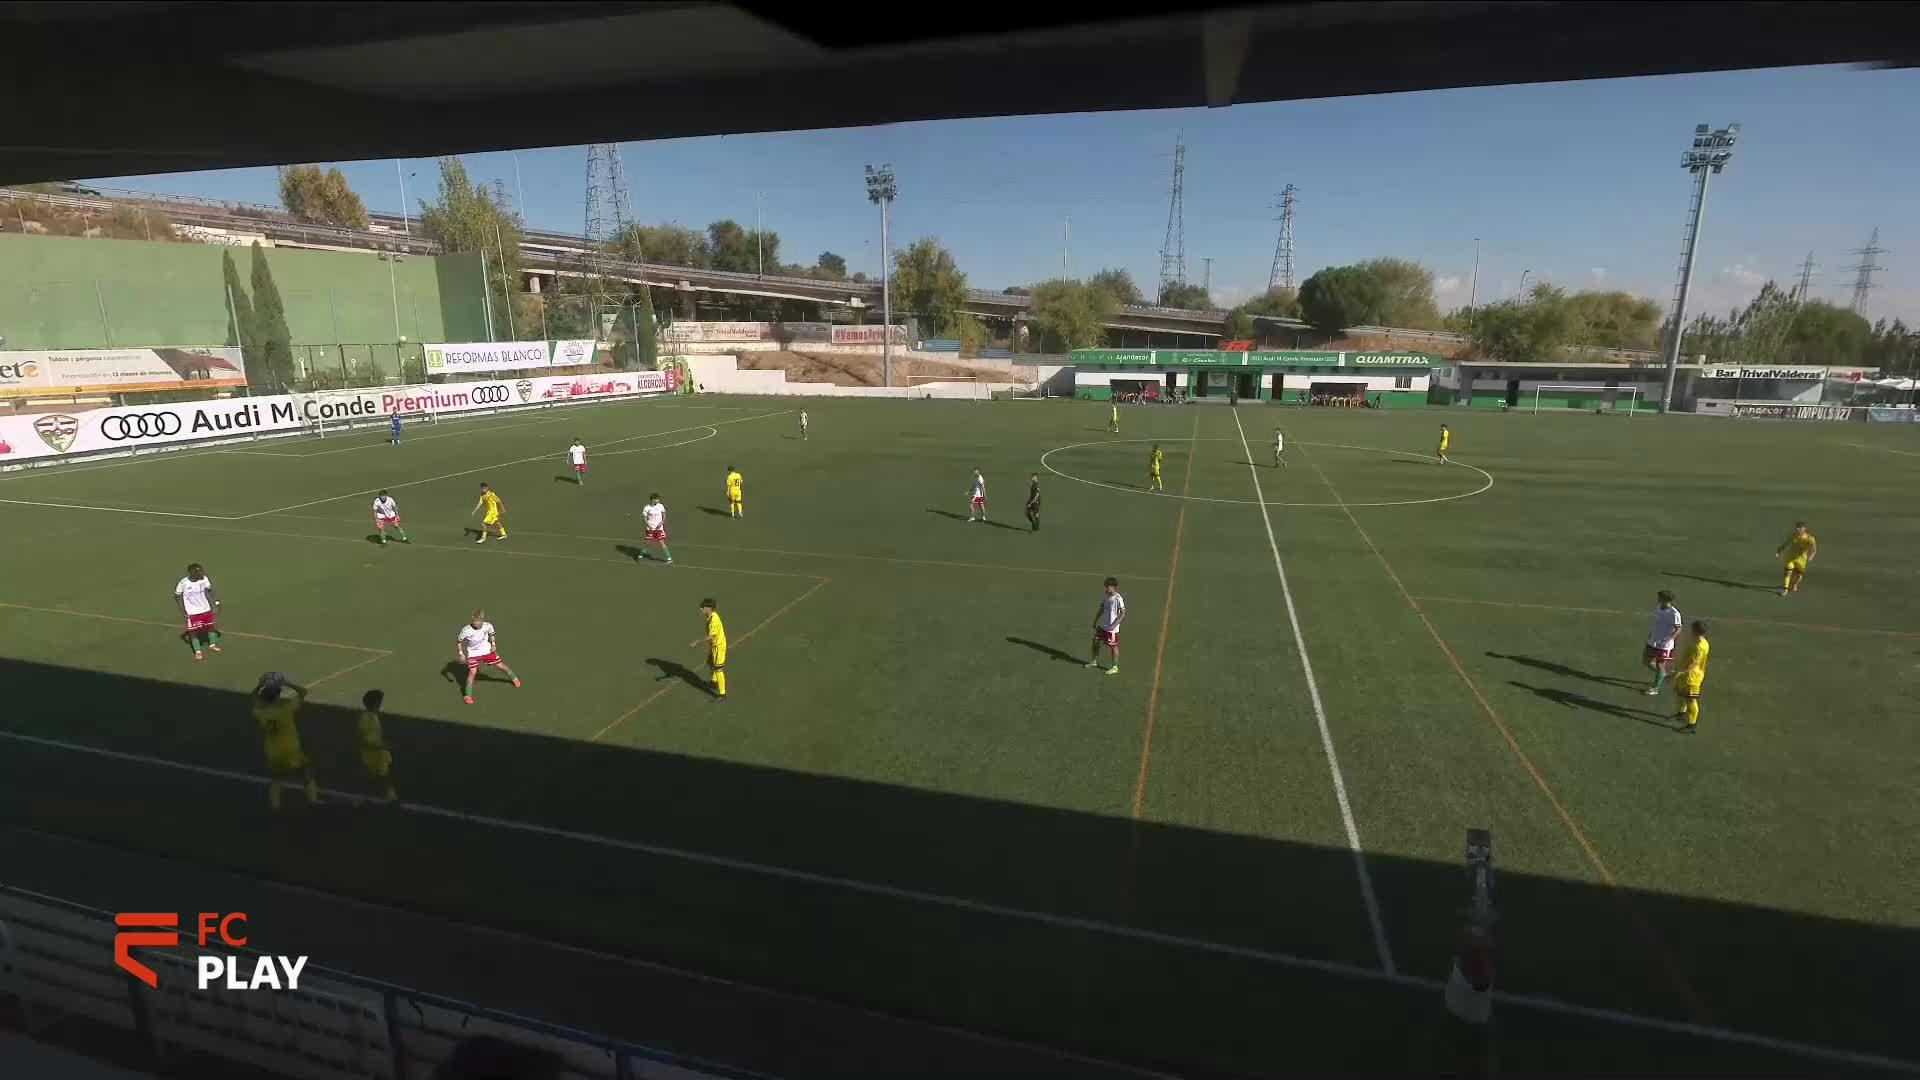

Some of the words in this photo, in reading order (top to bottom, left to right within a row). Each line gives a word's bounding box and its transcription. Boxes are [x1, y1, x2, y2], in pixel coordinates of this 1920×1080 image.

[446, 351, 499, 366] REFORMAS
[502, 348, 542, 362] BLANCO
[1355, 355, 1430, 364] QUAMTRAX
[1715, 369, 1736, 378] Bar
[1742, 369, 1822, 379] TrivalValderas
[191, 404, 261, 433] Audi
[382, 391, 469, 413] Premium
